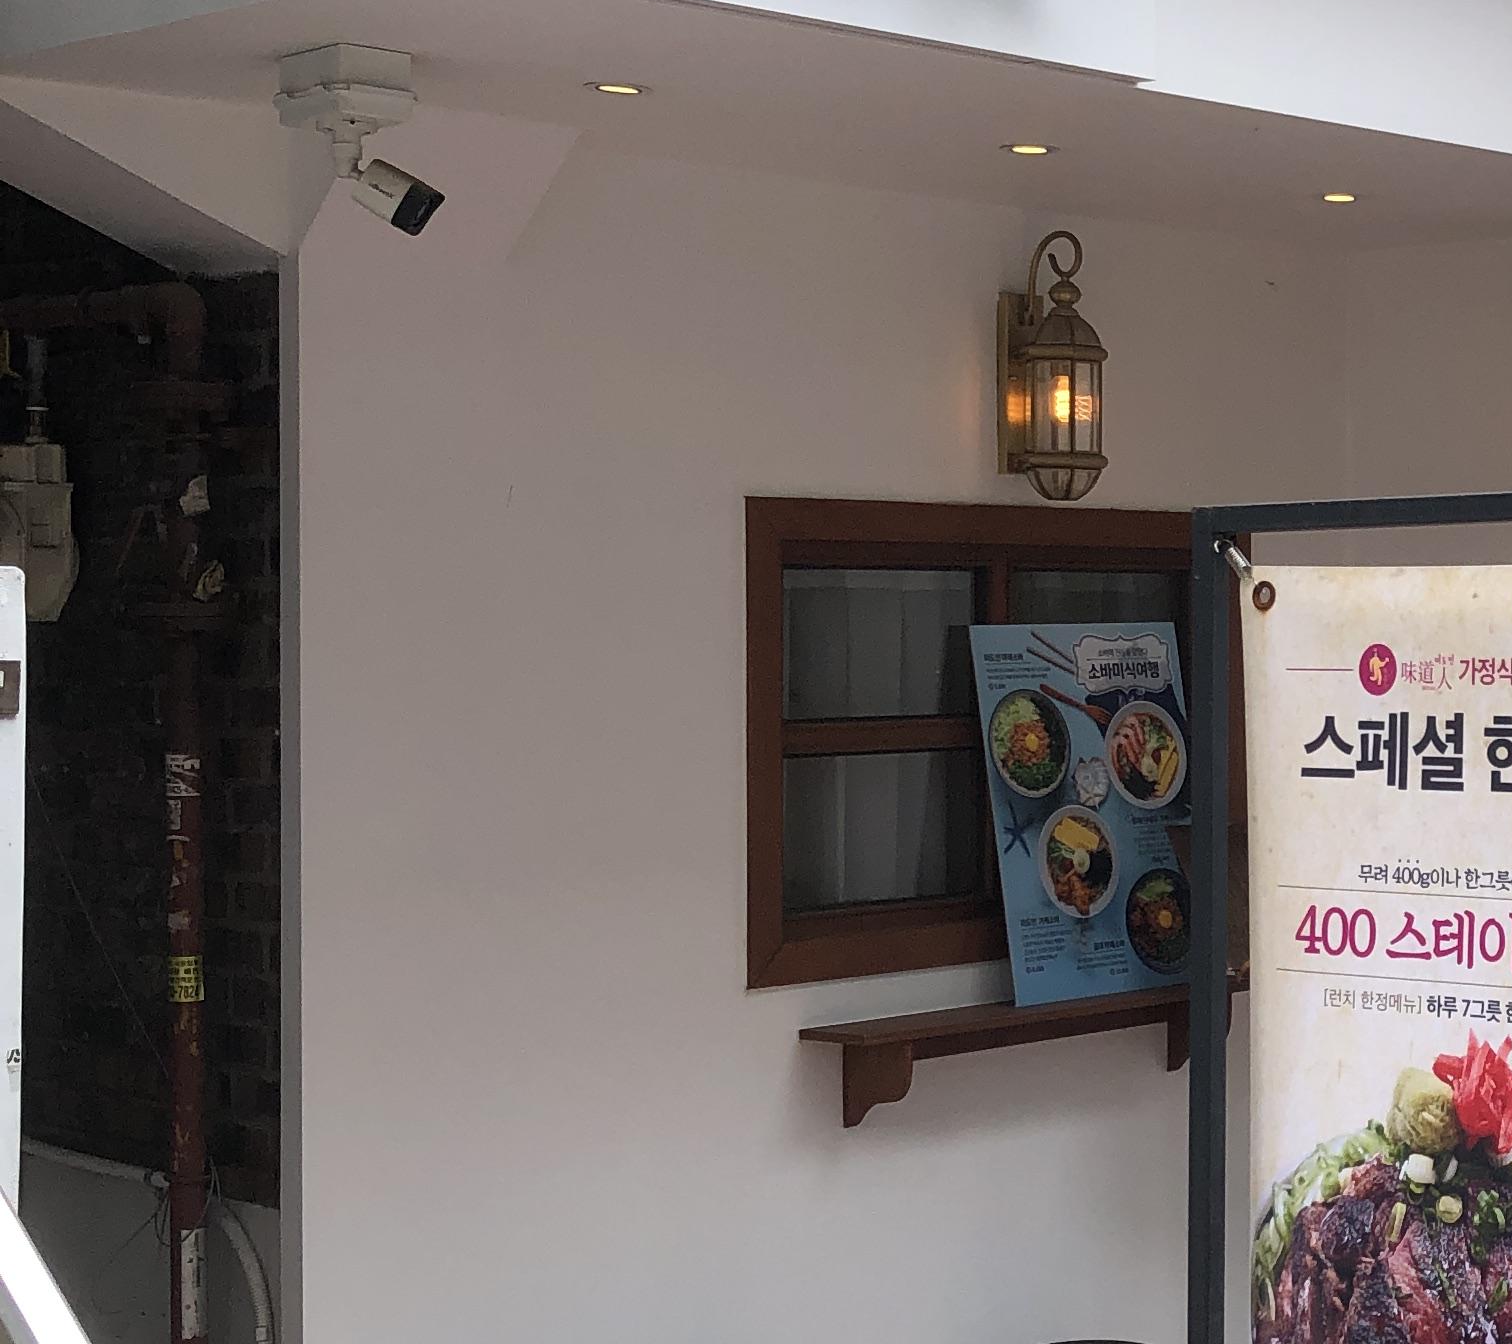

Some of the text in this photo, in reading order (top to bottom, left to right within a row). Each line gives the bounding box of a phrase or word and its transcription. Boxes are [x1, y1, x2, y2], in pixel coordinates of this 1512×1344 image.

[1401, 661, 1453, 690] 味道人
[1300, 711, 1465, 792] 스페셜
[1358, 864, 1388, 885] 무려
[1392, 864, 1462, 889] 400g이나
[1295, 904, 1377, 958] 400
[1426, 995, 1459, 1019] 하루
[1461, 998, 1501, 1023] 7그릇
